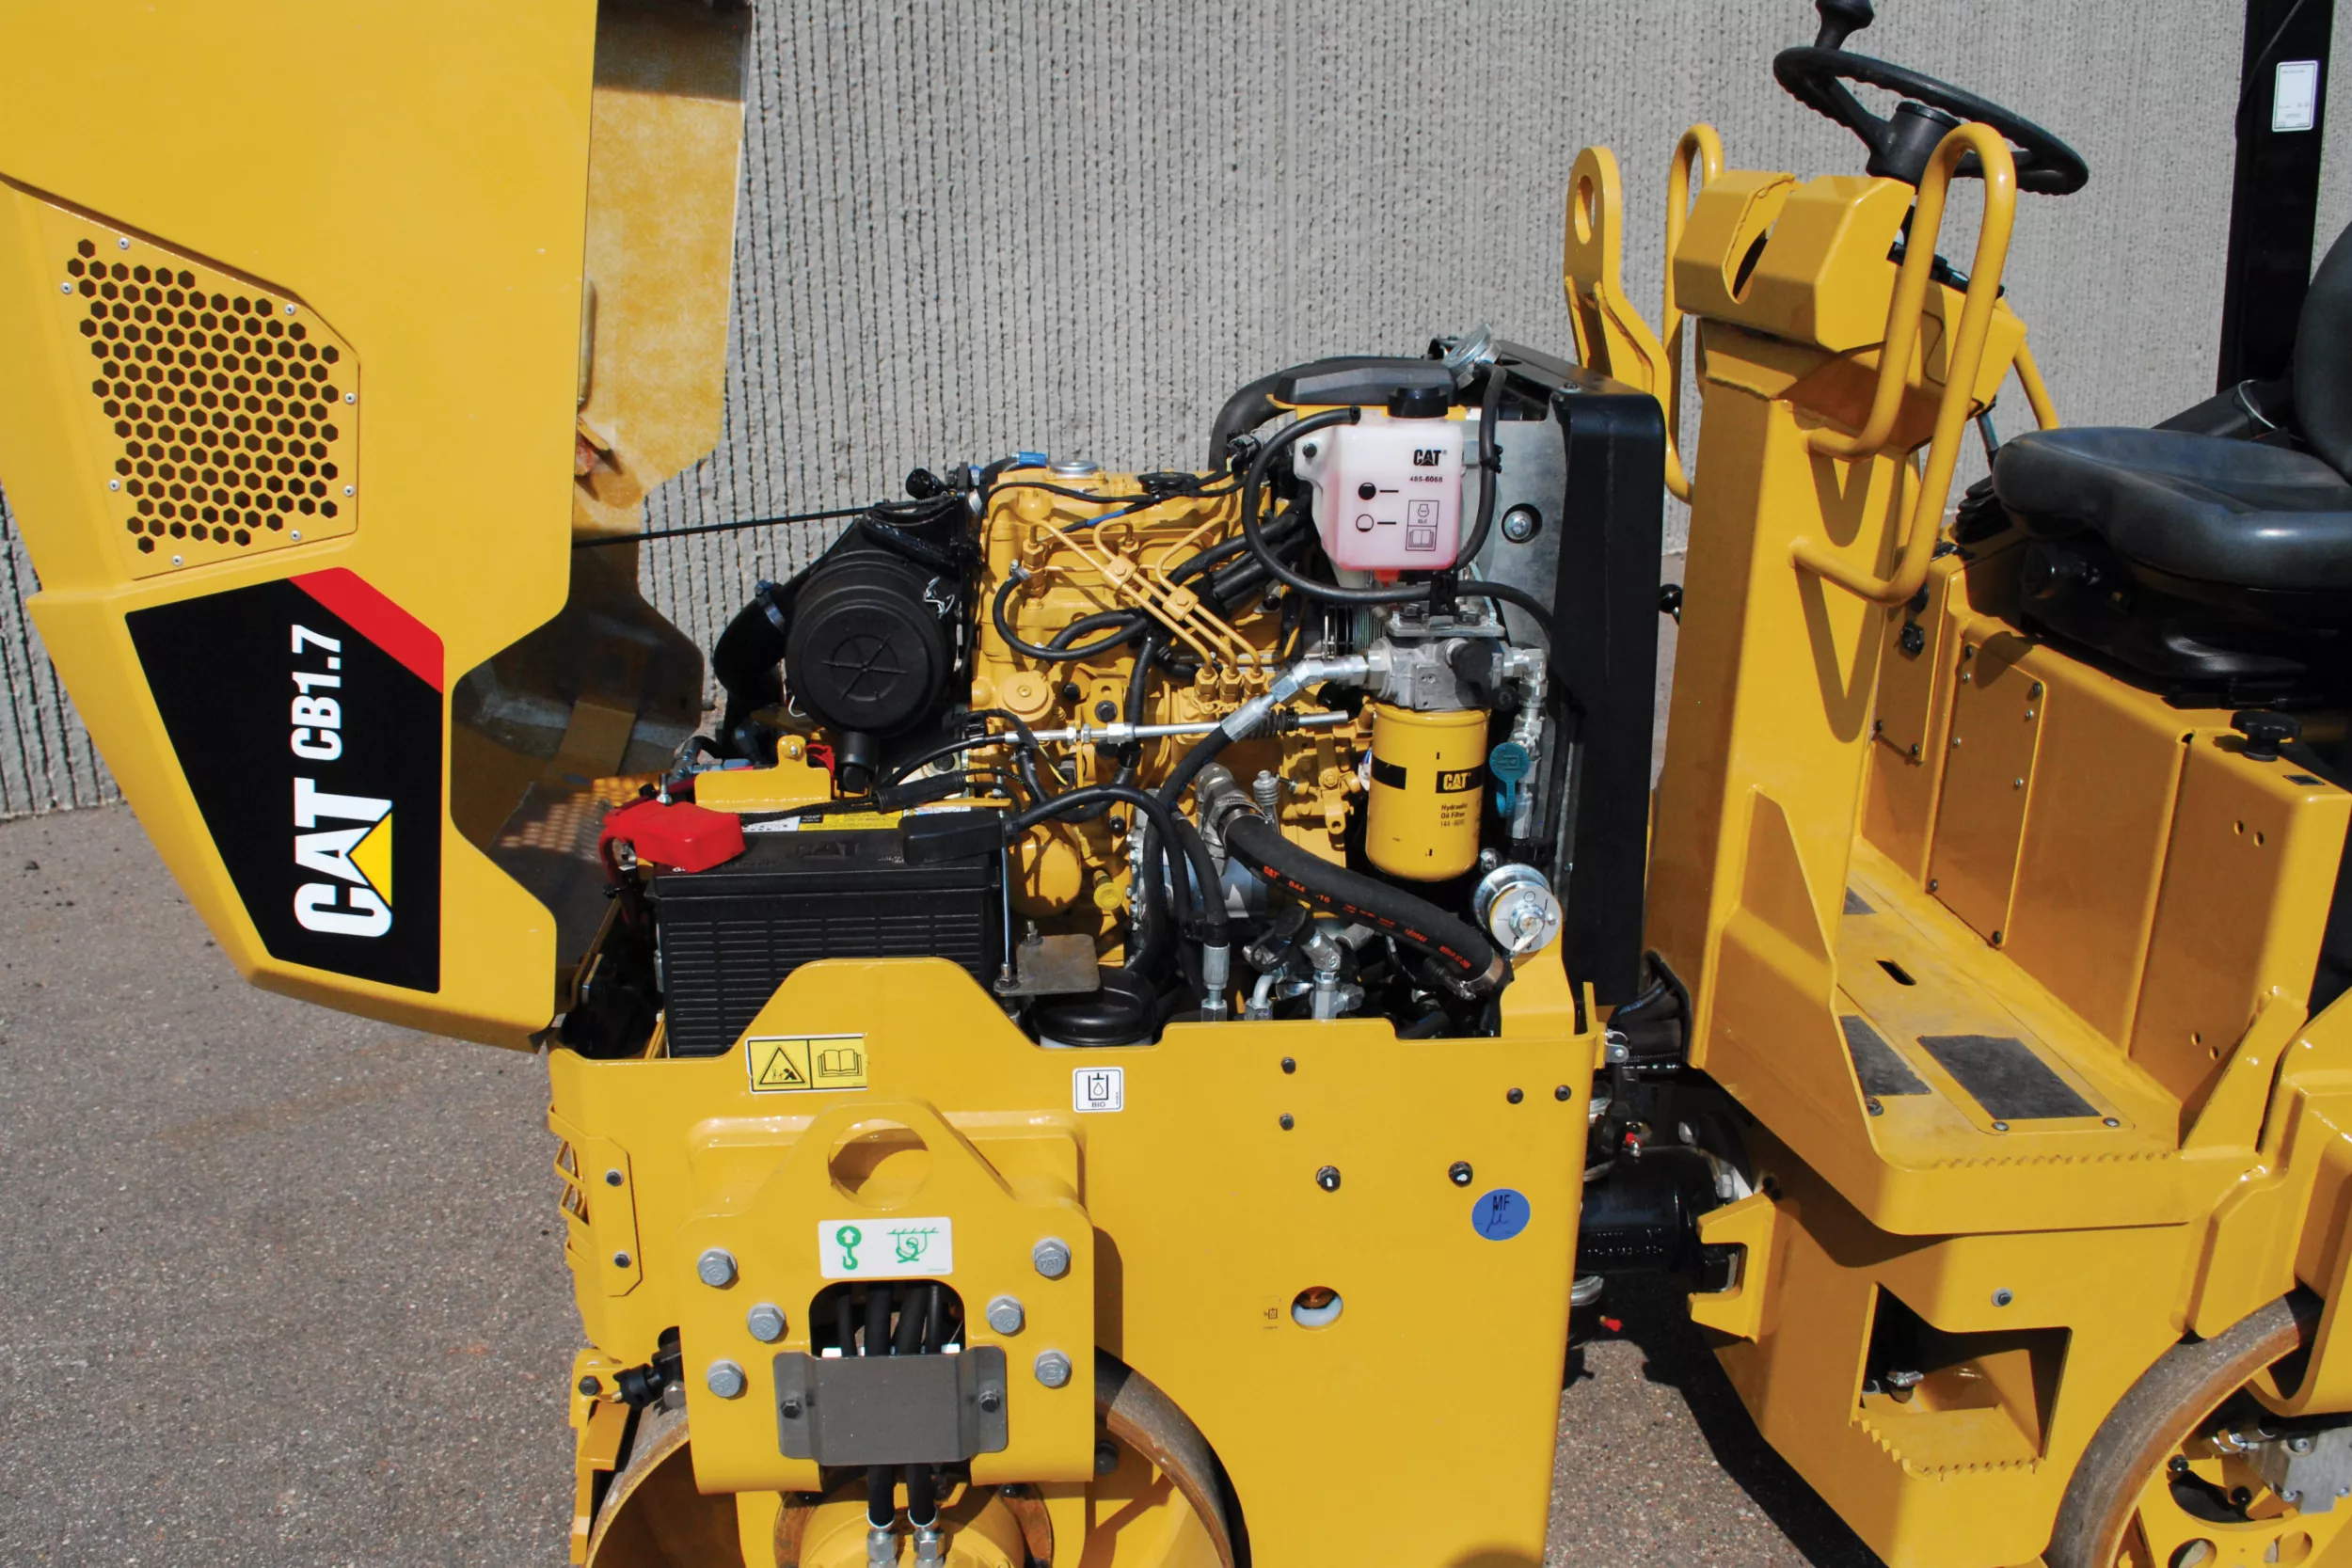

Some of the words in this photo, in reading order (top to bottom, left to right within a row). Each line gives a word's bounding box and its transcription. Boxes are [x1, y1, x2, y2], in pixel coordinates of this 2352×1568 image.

[1413, 449, 1442, 467] CAT
[290, 624, 343, 761] CB1.7
[1443, 772, 1468, 790] CAT
[1441, 803, 1468, 812] Hydraulic
[293, 776, 393, 938] CAT
